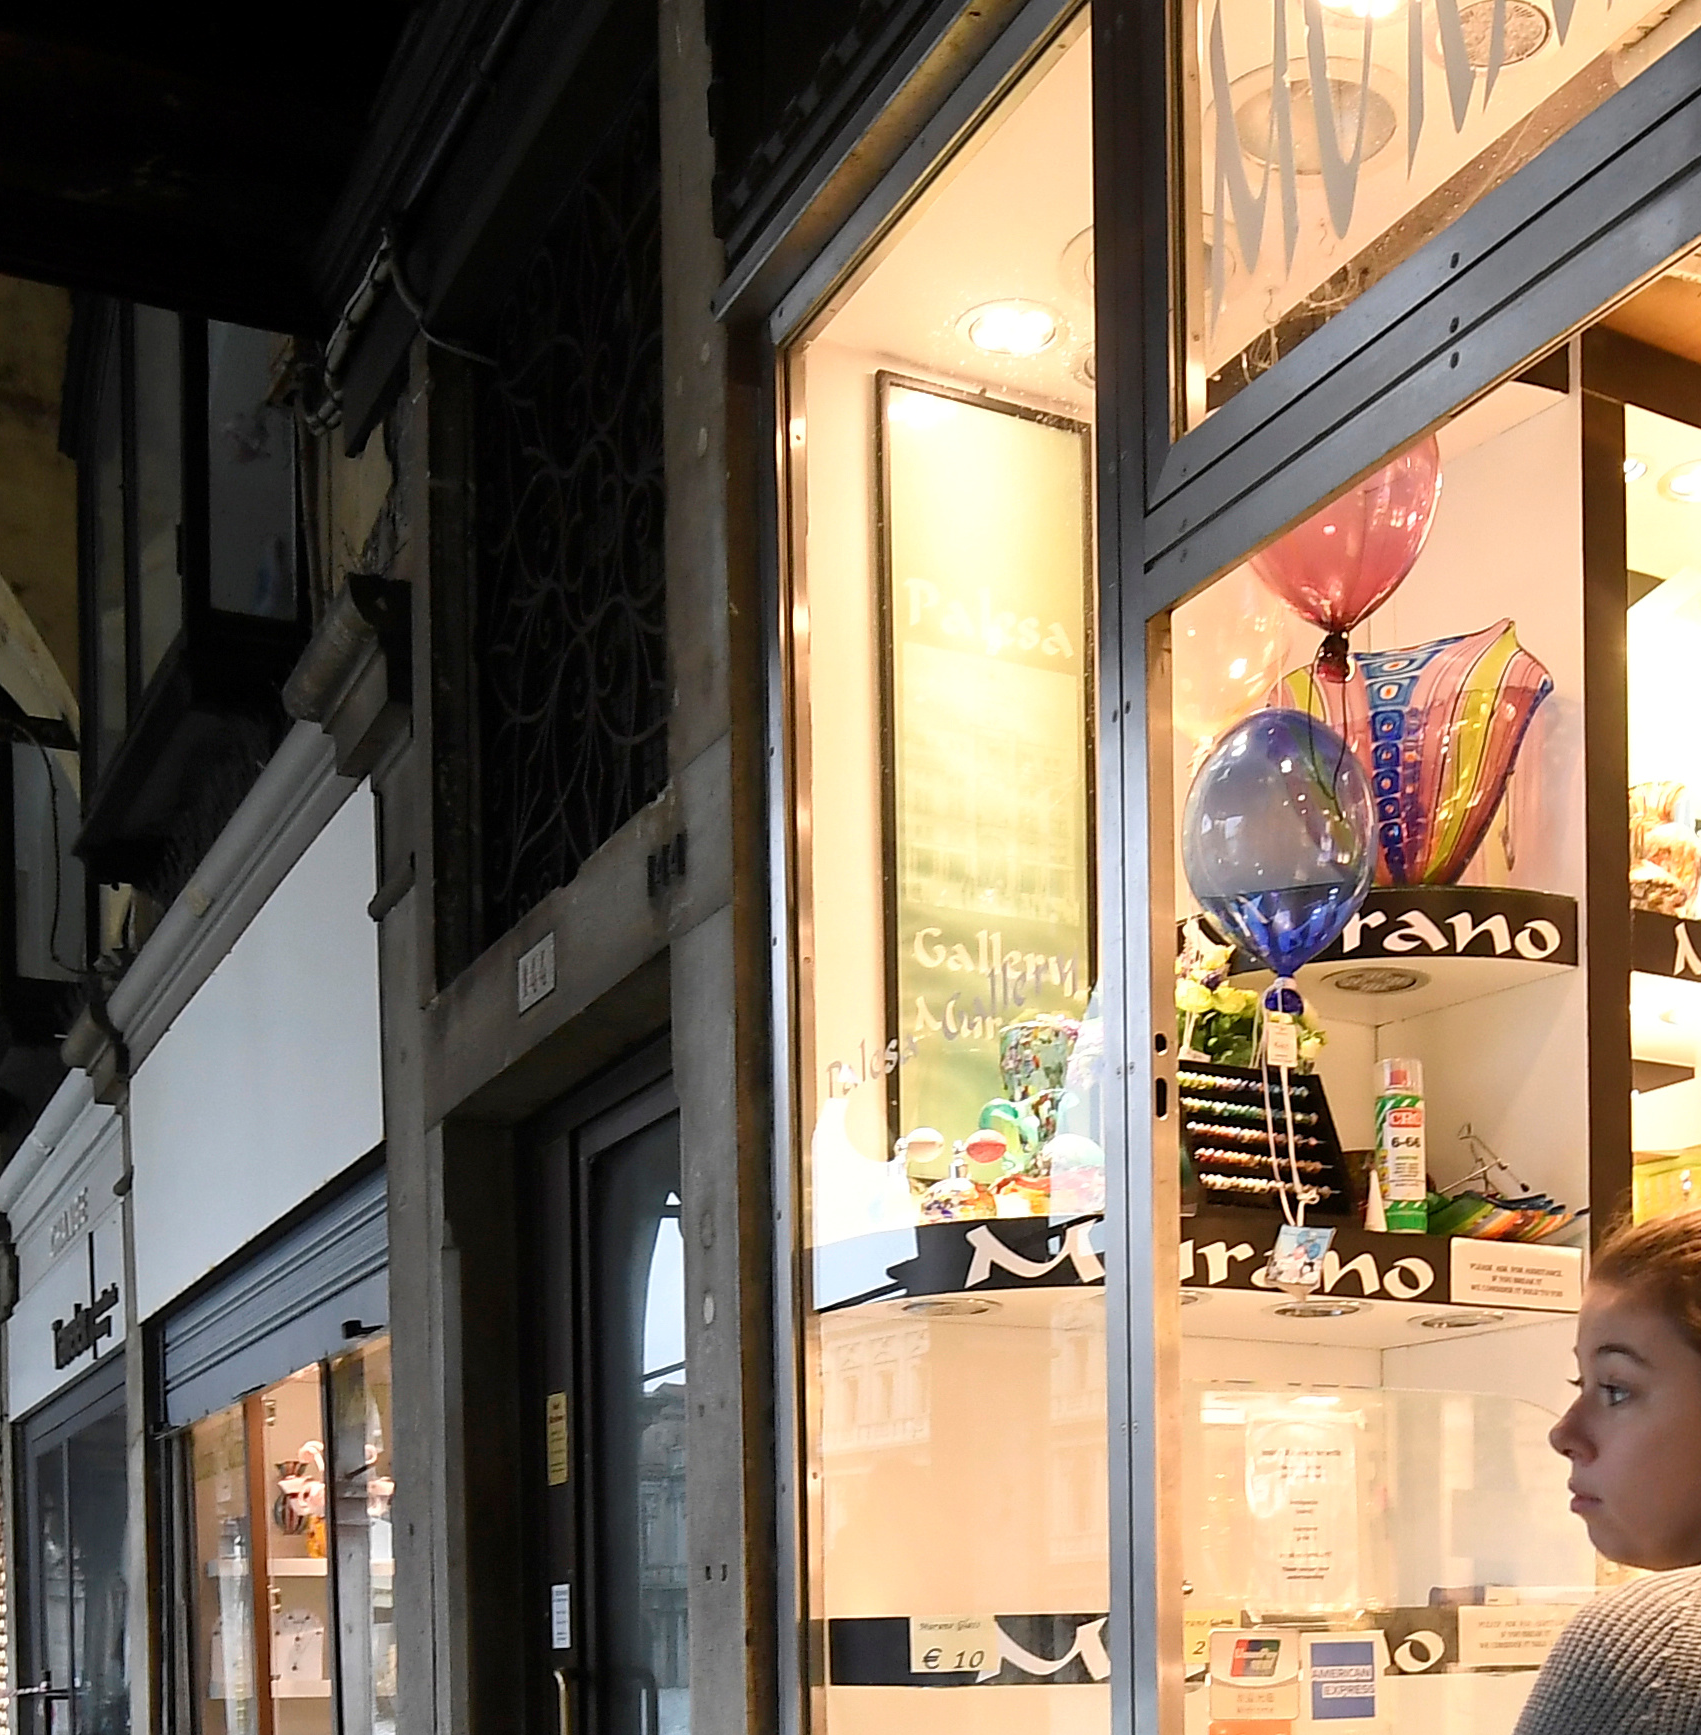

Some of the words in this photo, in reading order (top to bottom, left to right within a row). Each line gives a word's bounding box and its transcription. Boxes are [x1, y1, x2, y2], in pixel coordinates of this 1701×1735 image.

[902, 576, 1075, 660] Palesa
[911, 926, 1078, 999] Gallery
[922, 1647, 943, 1670] €
[953, 1650, 985, 1669] 10
[1311, 1667, 1373, 1680] AMERICAN
[1323, 1683, 1375, 1697] EXPRESS
